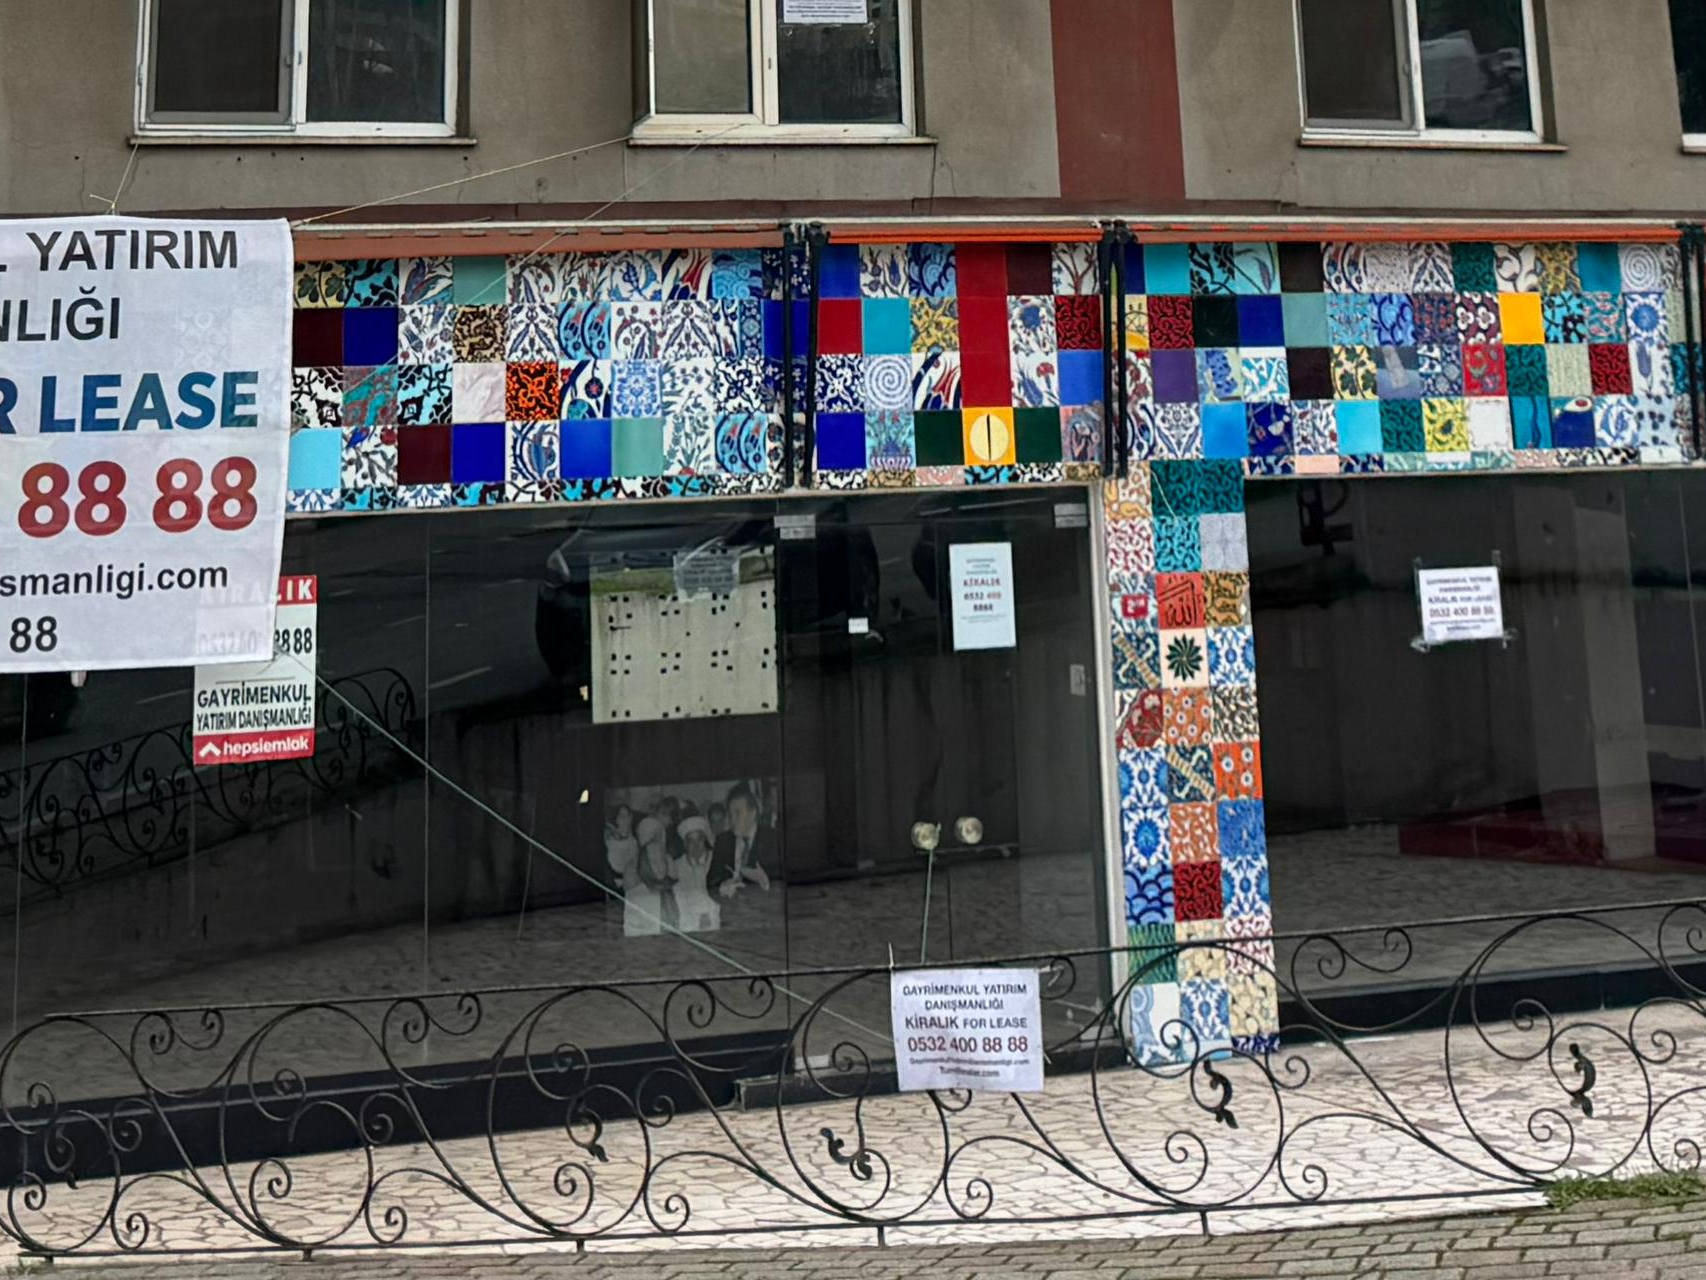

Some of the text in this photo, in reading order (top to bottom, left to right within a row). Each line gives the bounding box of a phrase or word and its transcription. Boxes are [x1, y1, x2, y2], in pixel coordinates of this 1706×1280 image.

[25, 228, 241, 273] YATIRIM
[40, 369, 260, 434] LEASE
[16, 458, 129, 540] 88
[151, 452, 259, 532] 88
[8, 614, 60, 655] 88
[197, 681, 313, 708] GAYRİMENKUL
[196, 711, 236, 732] YATIRIM
[902, 982, 1028, 997] GAYRİMENKUL YATIRIM
[924, 998, 1004, 1012] DANIŞMANLIĞI
[905, 1012, 1028, 1029] KİRALIK FOR LEASE
[907, 1036, 1029, 1053] 0532 400 88 88
